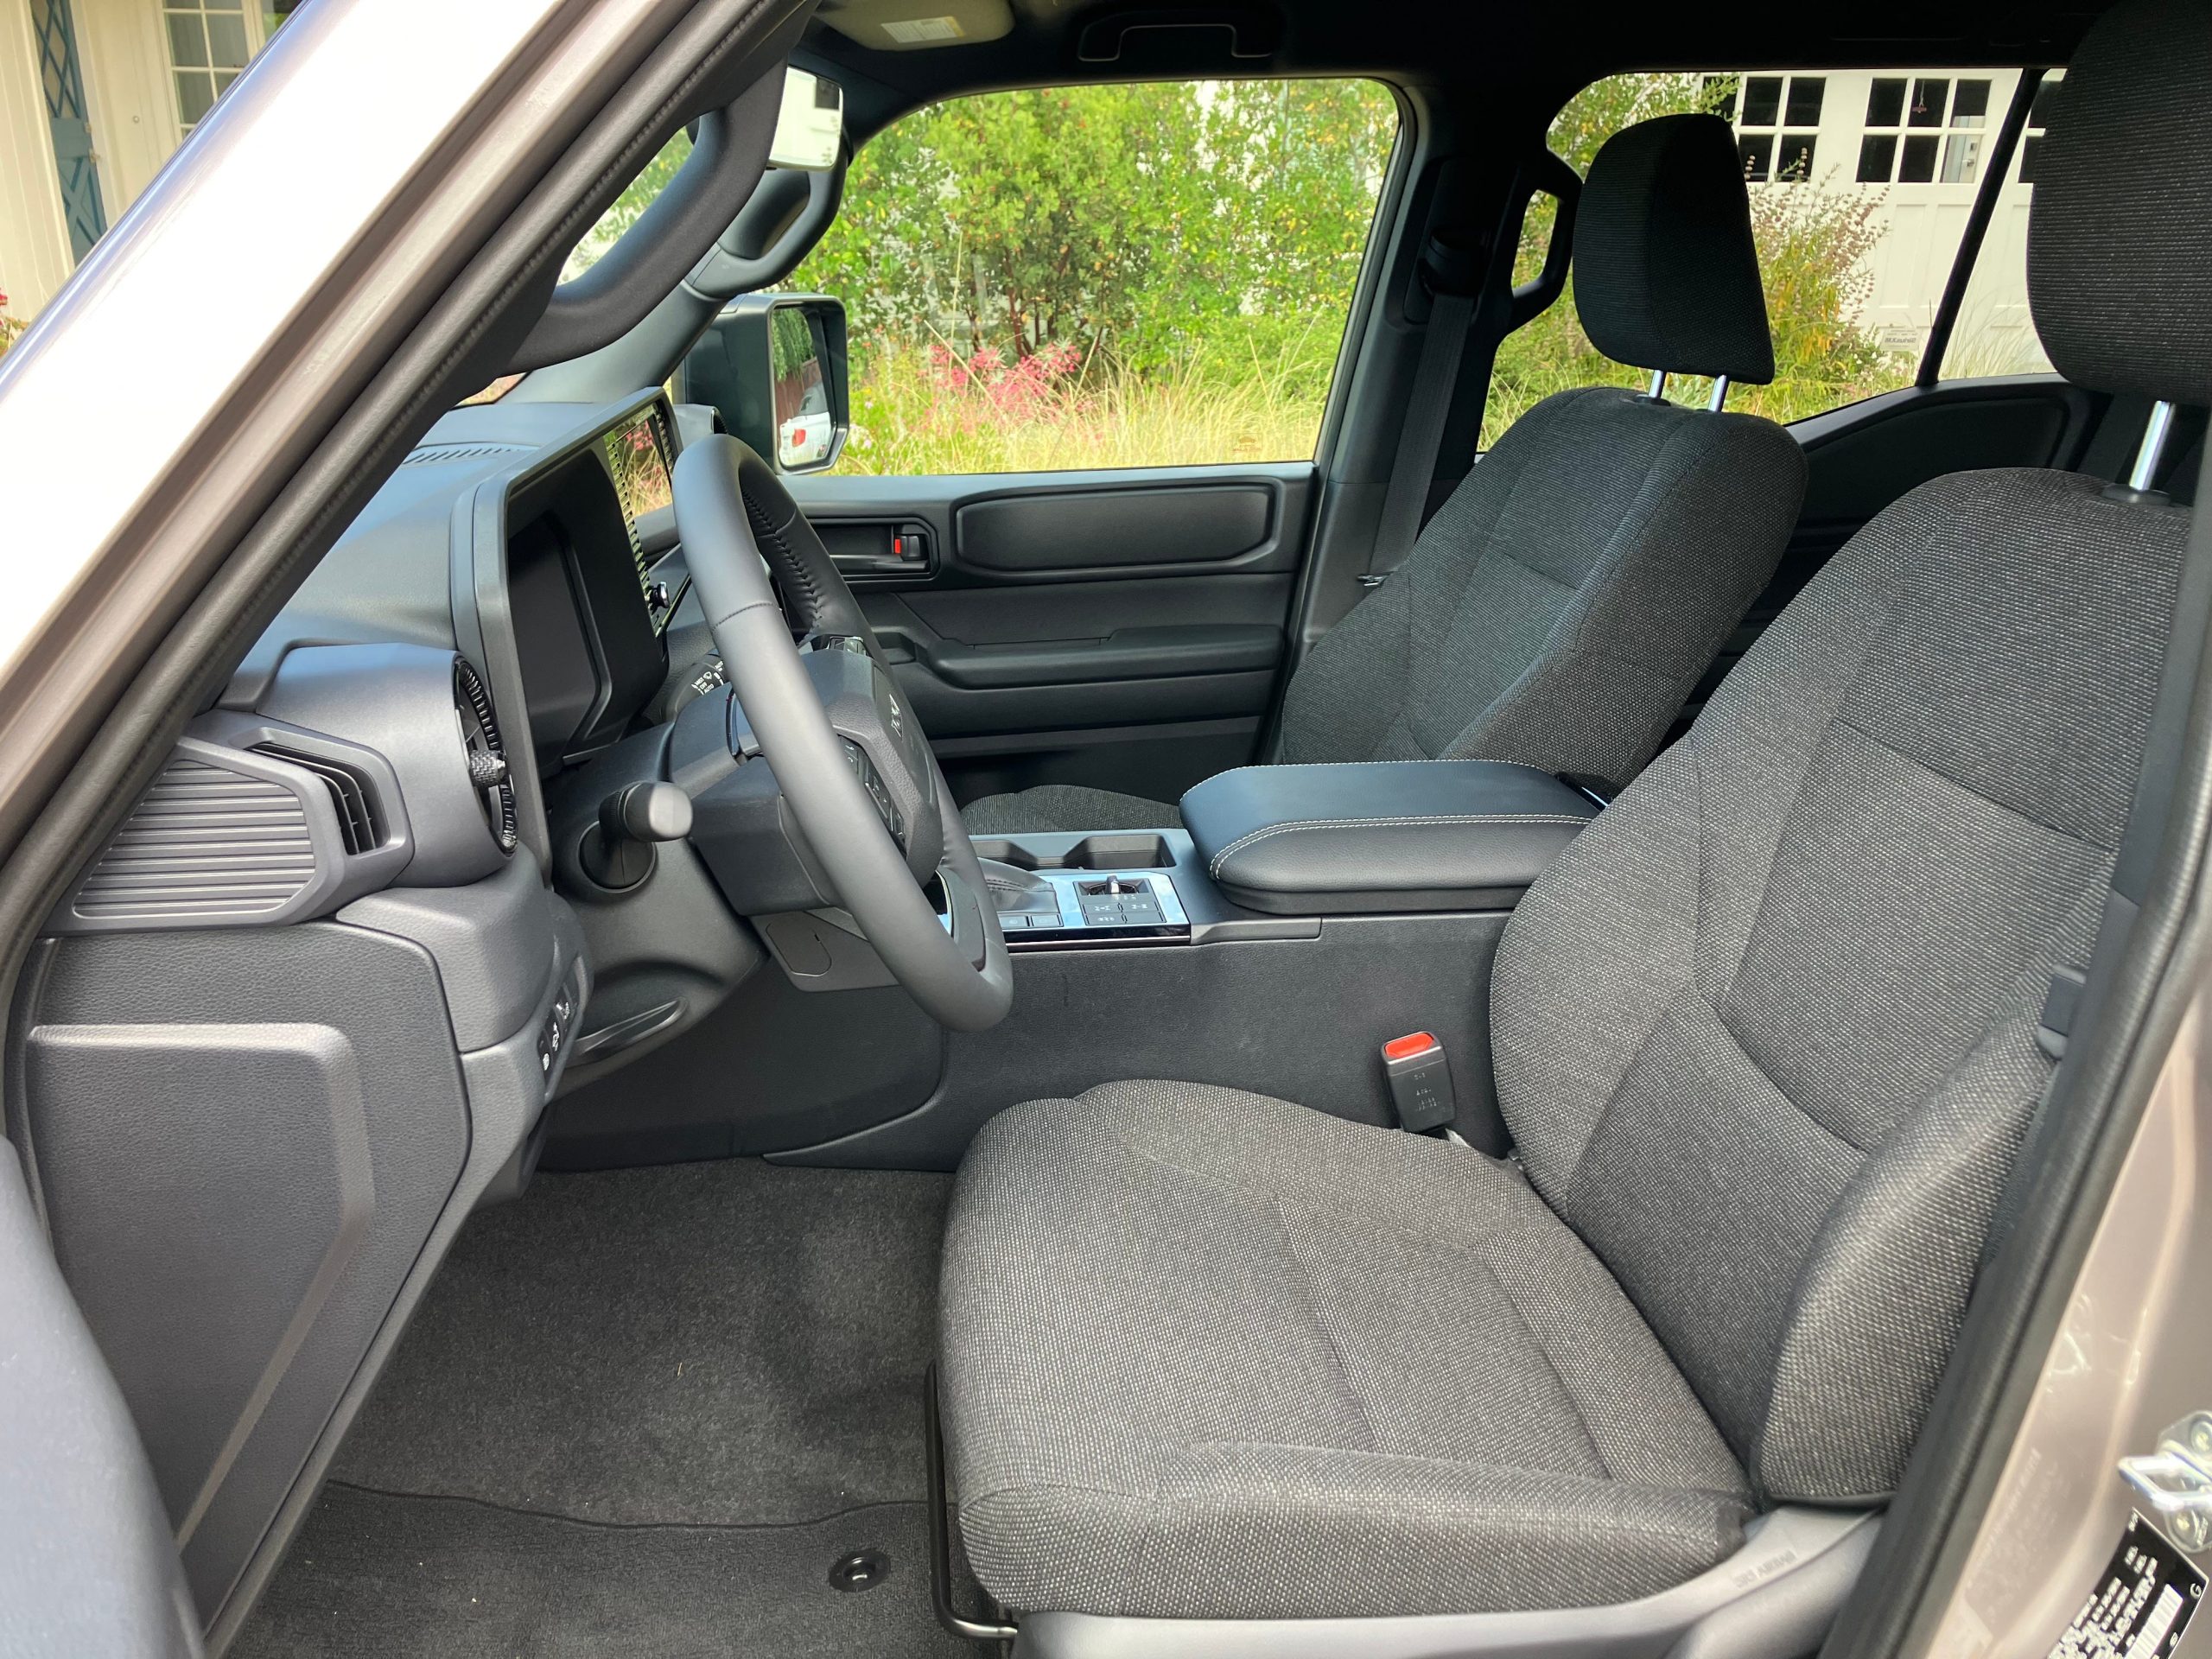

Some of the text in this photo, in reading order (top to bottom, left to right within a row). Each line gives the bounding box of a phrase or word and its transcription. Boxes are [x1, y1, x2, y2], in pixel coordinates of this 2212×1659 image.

[699, 681, 708, 690] OFF
[704, 683, 715, 694] AUTO
[1757, 1549, 1796, 1578] AIRBAG
[2190, 1583, 2202, 1599] G
